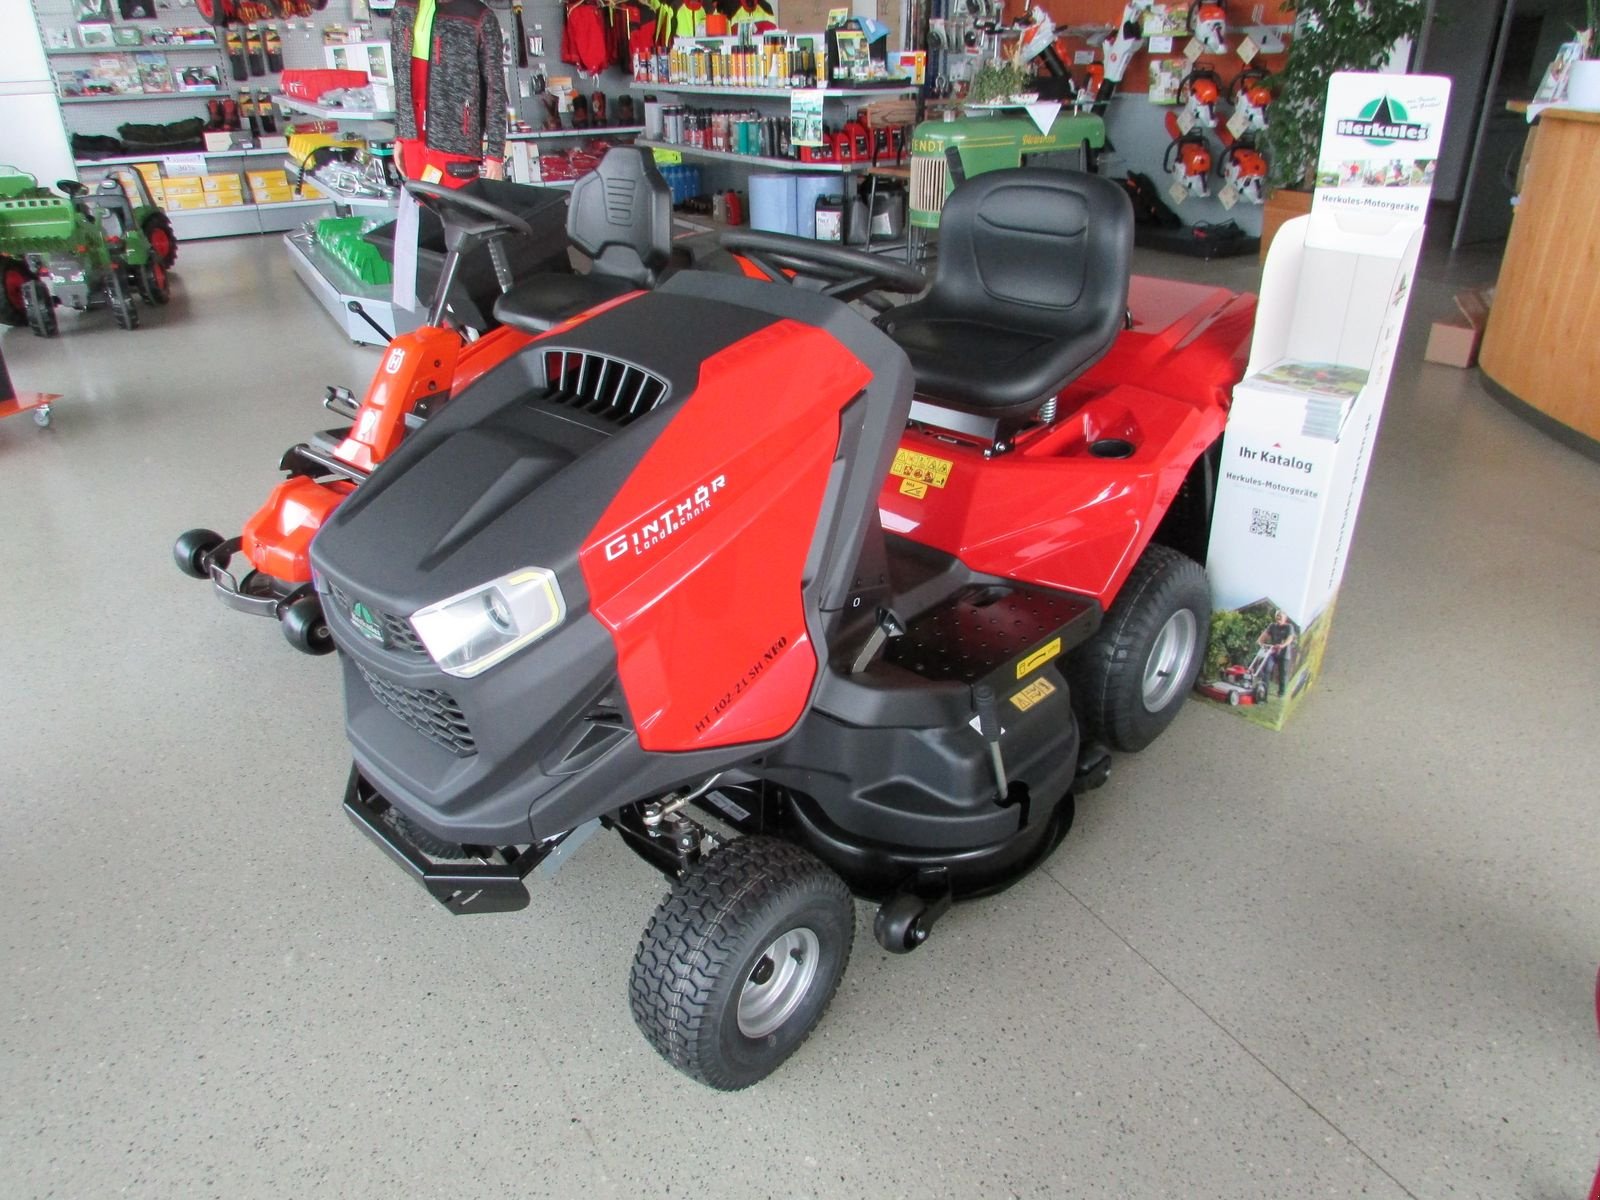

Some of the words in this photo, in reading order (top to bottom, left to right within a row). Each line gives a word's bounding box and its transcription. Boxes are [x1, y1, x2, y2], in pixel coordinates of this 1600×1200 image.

[1338, 121, 1428, 140] Herkules
[911, 138, 944, 153] ENDT
[1322, 194, 1420, 212] Herkules-Motorgeräte
[1239, 446, 1257, 460] Ihr
[1260, 451, 1313, 473] Katalog
[1226, 471, 1318, 499] Herkules-Motorgeräte
[694, 714, 711, 733] HT
[748, 661, 764, 680] SH
[763, 636, 788, 663] NEO
